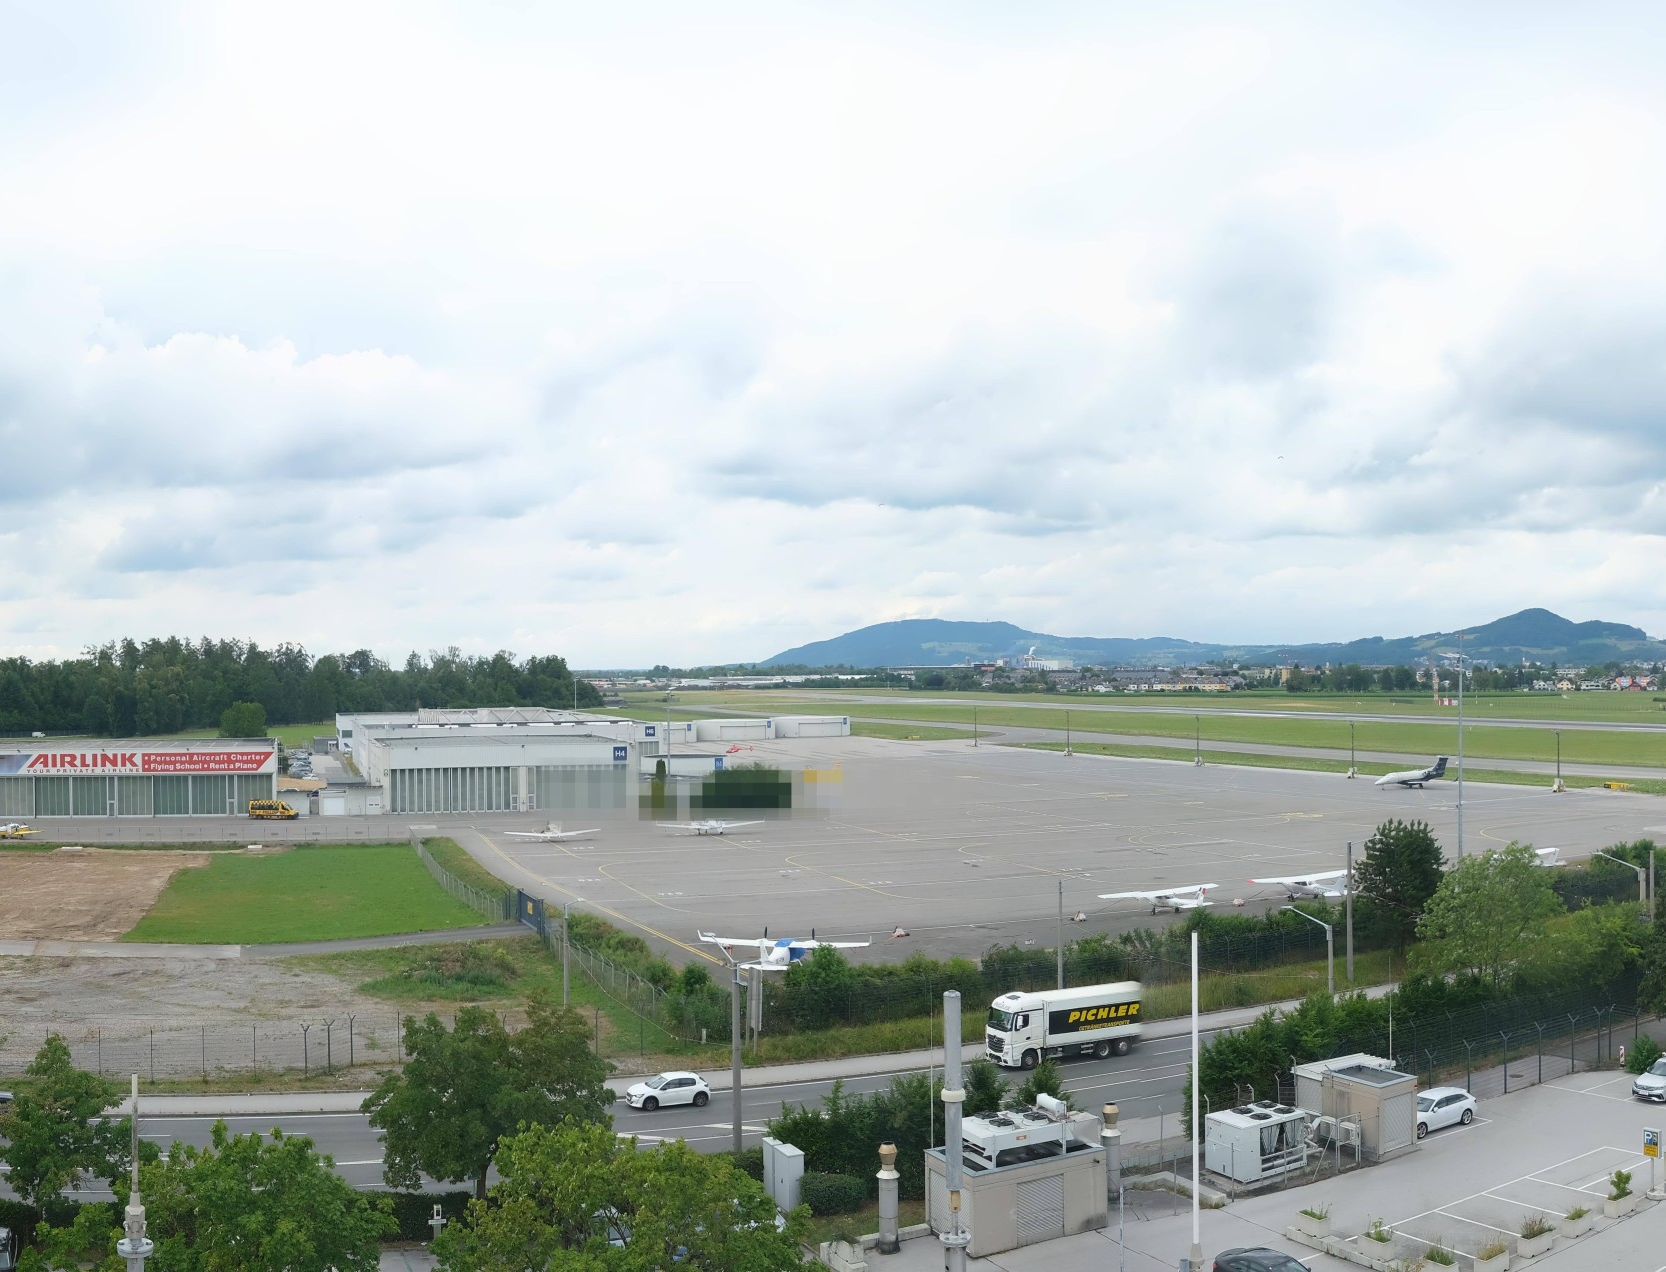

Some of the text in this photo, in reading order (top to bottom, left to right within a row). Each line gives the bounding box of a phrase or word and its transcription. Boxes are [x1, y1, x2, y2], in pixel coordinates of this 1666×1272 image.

[27, 753, 139, 768] AIRLINK
[230, 753, 265, 761] Charter
[150, 763, 174, 771] Flying
[175, 762, 202, 770] School
[1068, 1003, 1140, 1023] PICHLER
